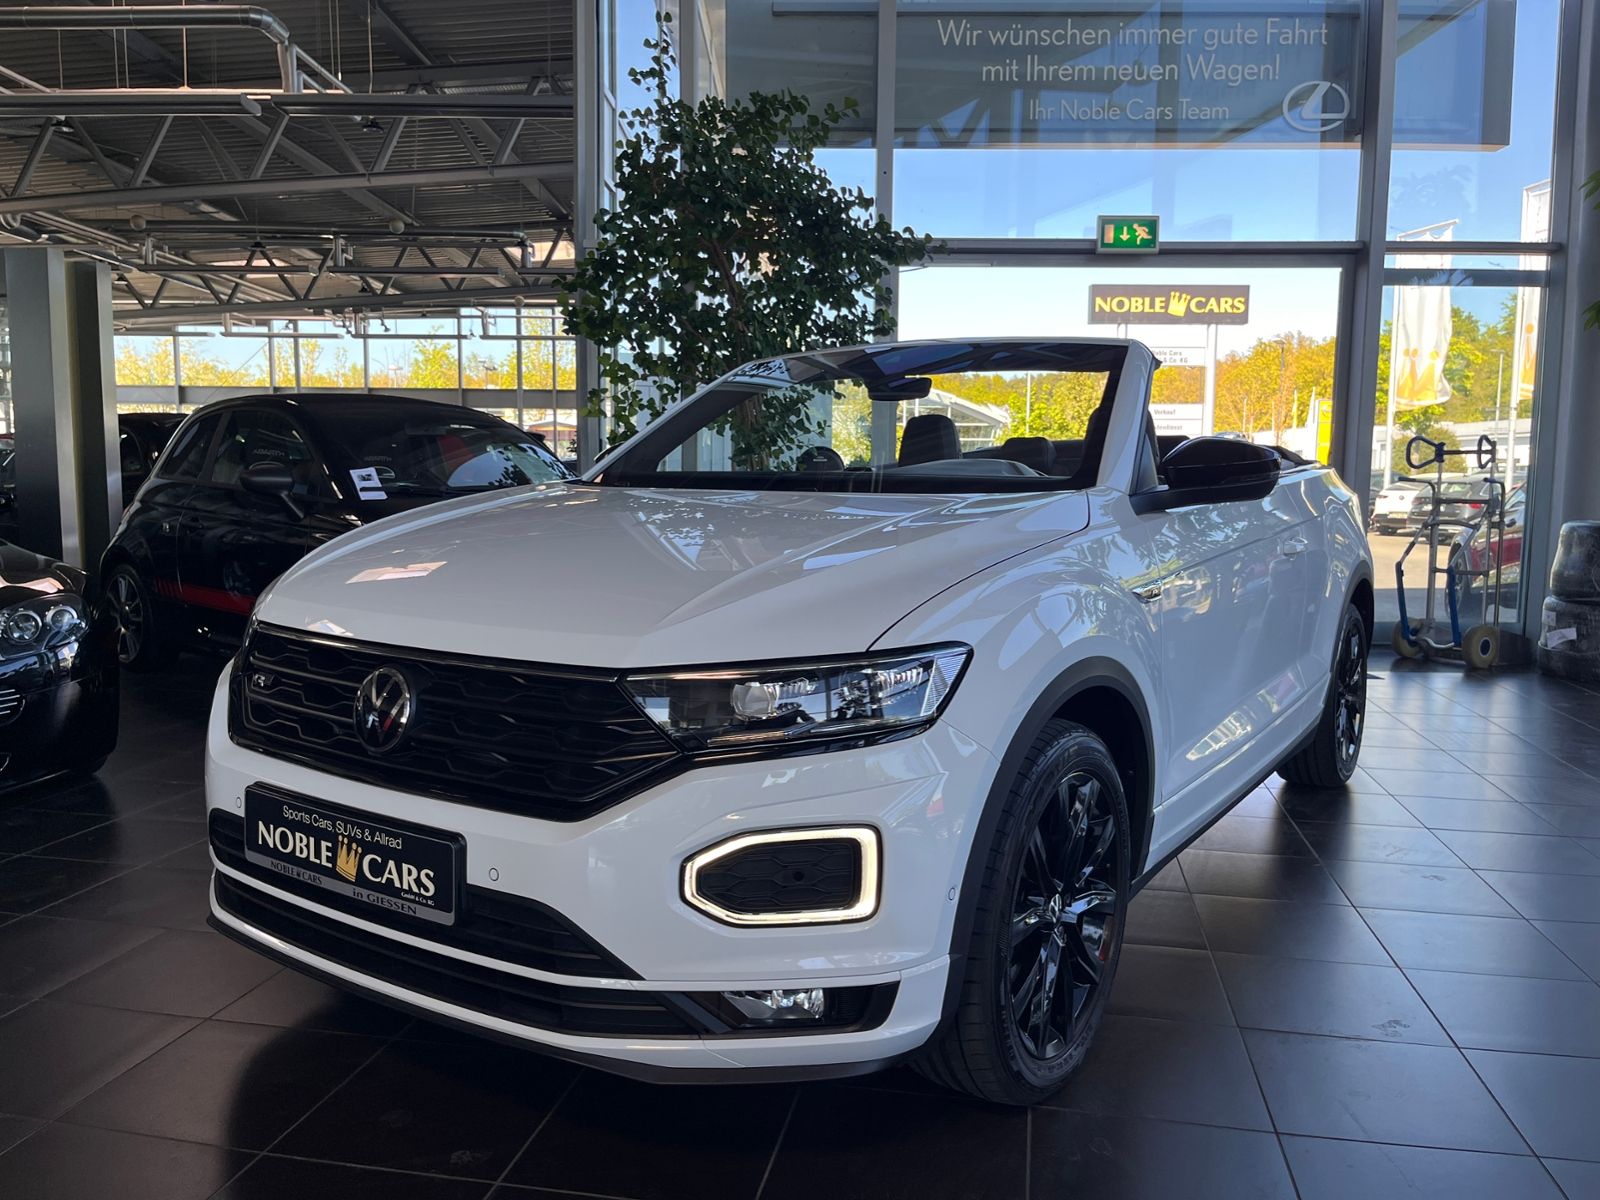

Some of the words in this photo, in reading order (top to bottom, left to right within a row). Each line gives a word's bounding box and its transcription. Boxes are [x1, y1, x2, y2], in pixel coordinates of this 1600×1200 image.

[937, 19, 982, 46] Wir
[988, 18, 1111, 46] wünschen
[1119, 22, 1197, 45] immer
[1204, 22, 1258, 51] gute
[1267, 18, 1328, 45] Fahrt
[982, 59, 1019, 82] mit
[1026, 54, 1096, 82] Ihrem
[1103, 63, 1178, 82] neuen
[1187, 54, 1280, 86] Wagen!
[1029, 99, 1055, 120] Ihr
[1061, 99, 1121, 120] Noble
[1126, 98, 1173, 120] Cars
[1179, 98, 1230, 120] Team
[1095, 297, 1166, 313] NOBLE
[1190, 297, 1245, 313] CARS
[283, 805, 311, 825] Sports
[336, 820, 362, 841] SUVs
[364, 829, 371, 842] &
[374, 831, 402, 849] Allrad
[258, 820, 333, 868] NOBLE
[362, 853, 436, 897] CARS
[270, 860, 295, 876] NOBLE
[302, 871, 323, 886] CARS
[352, 887, 363, 900] in
[366, 893, 417, 915] GIESSEN
